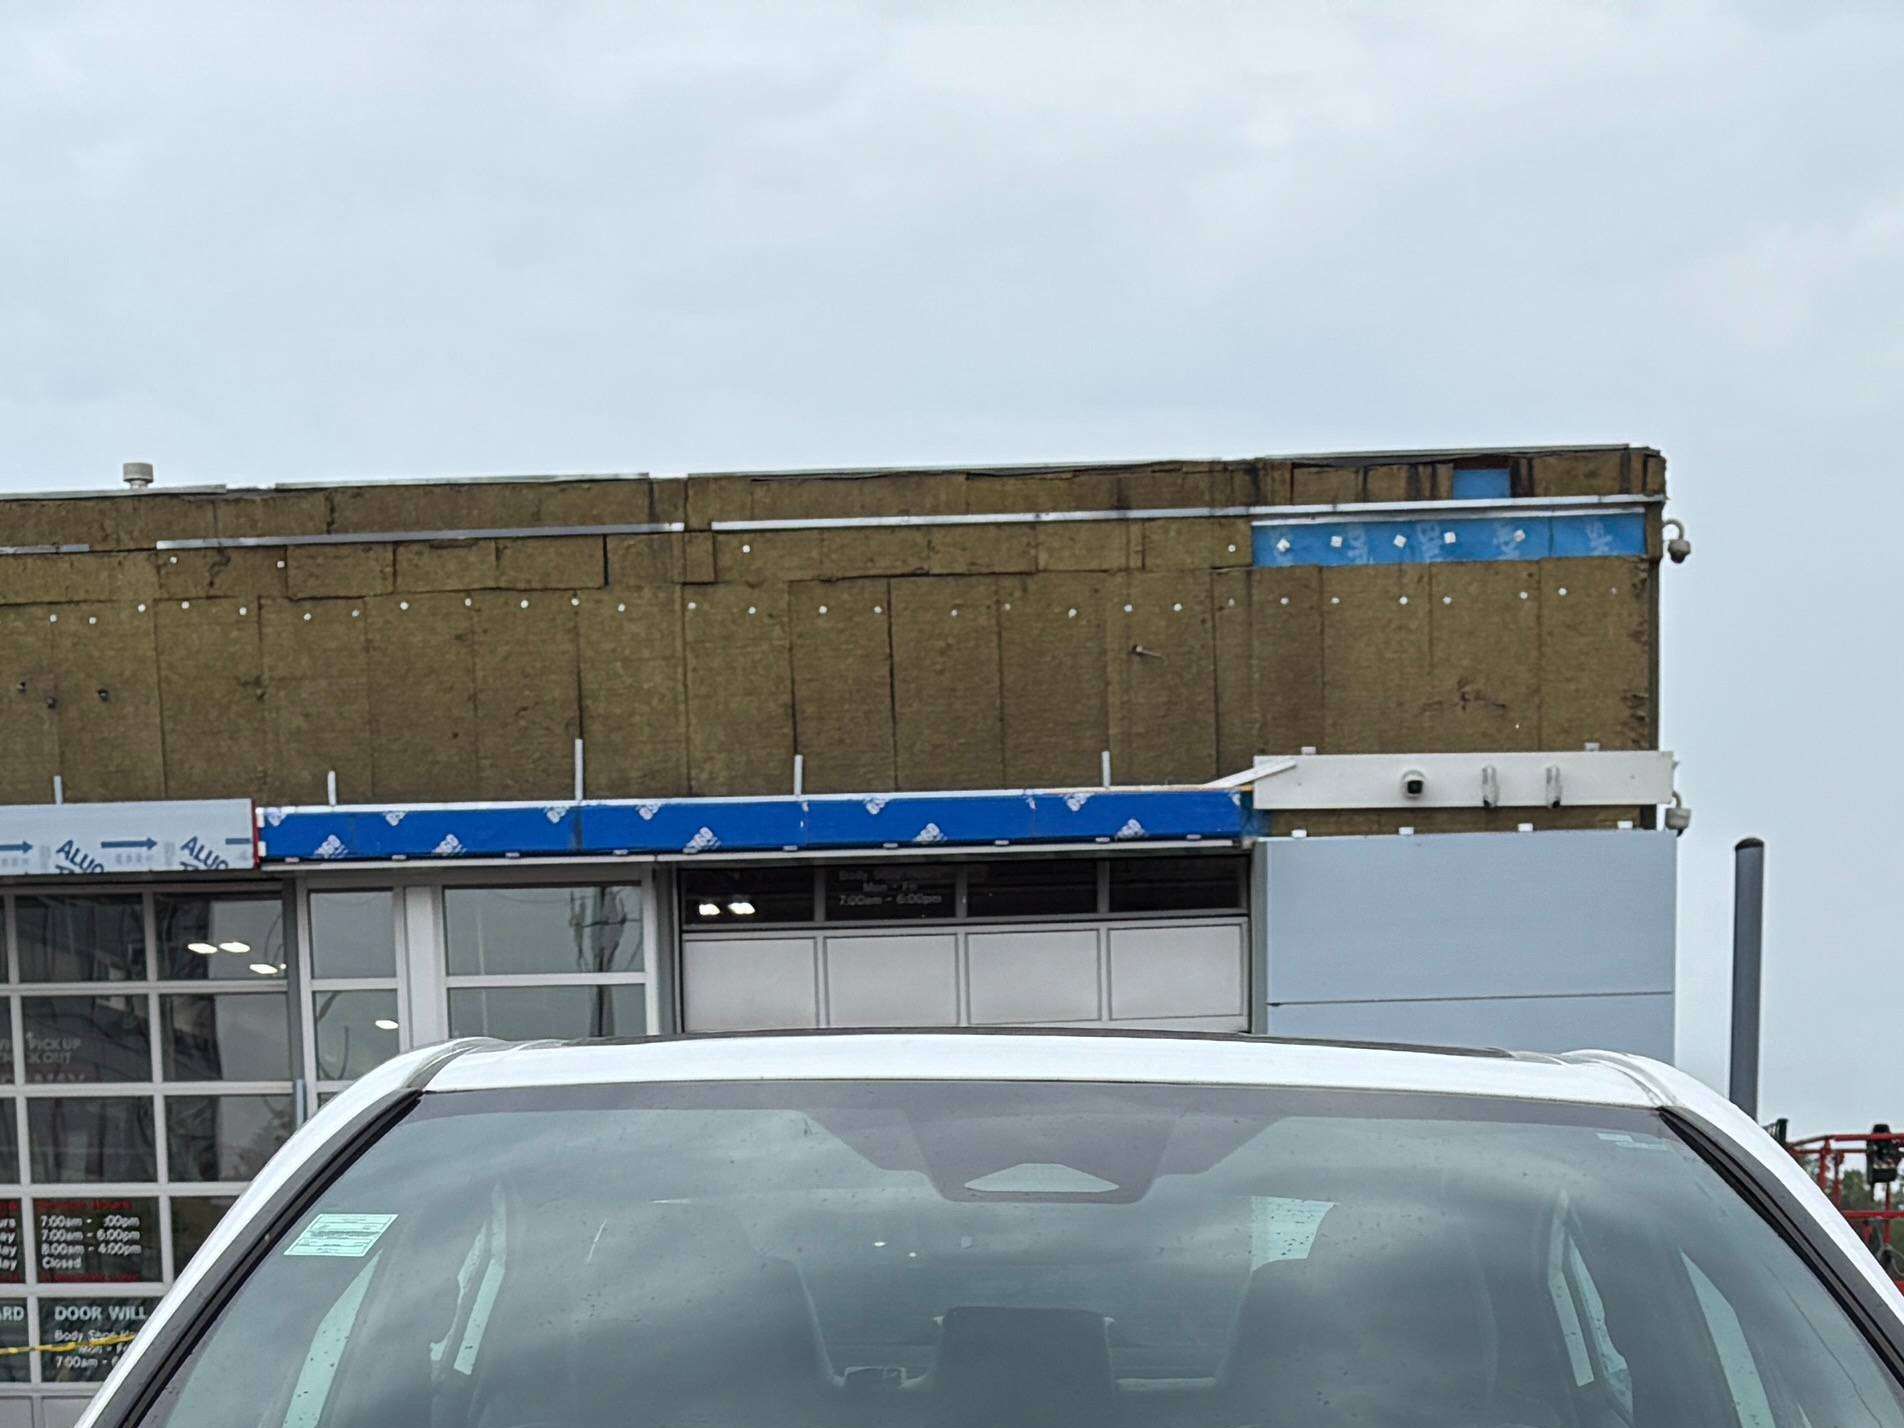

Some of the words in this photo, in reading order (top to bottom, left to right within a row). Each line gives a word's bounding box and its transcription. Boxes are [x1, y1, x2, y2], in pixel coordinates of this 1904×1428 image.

[42, 1257, 82, 1269] Closed
[54, 1306, 102, 1321] DOOR
[108, 1306, 147, 1320] WILL
